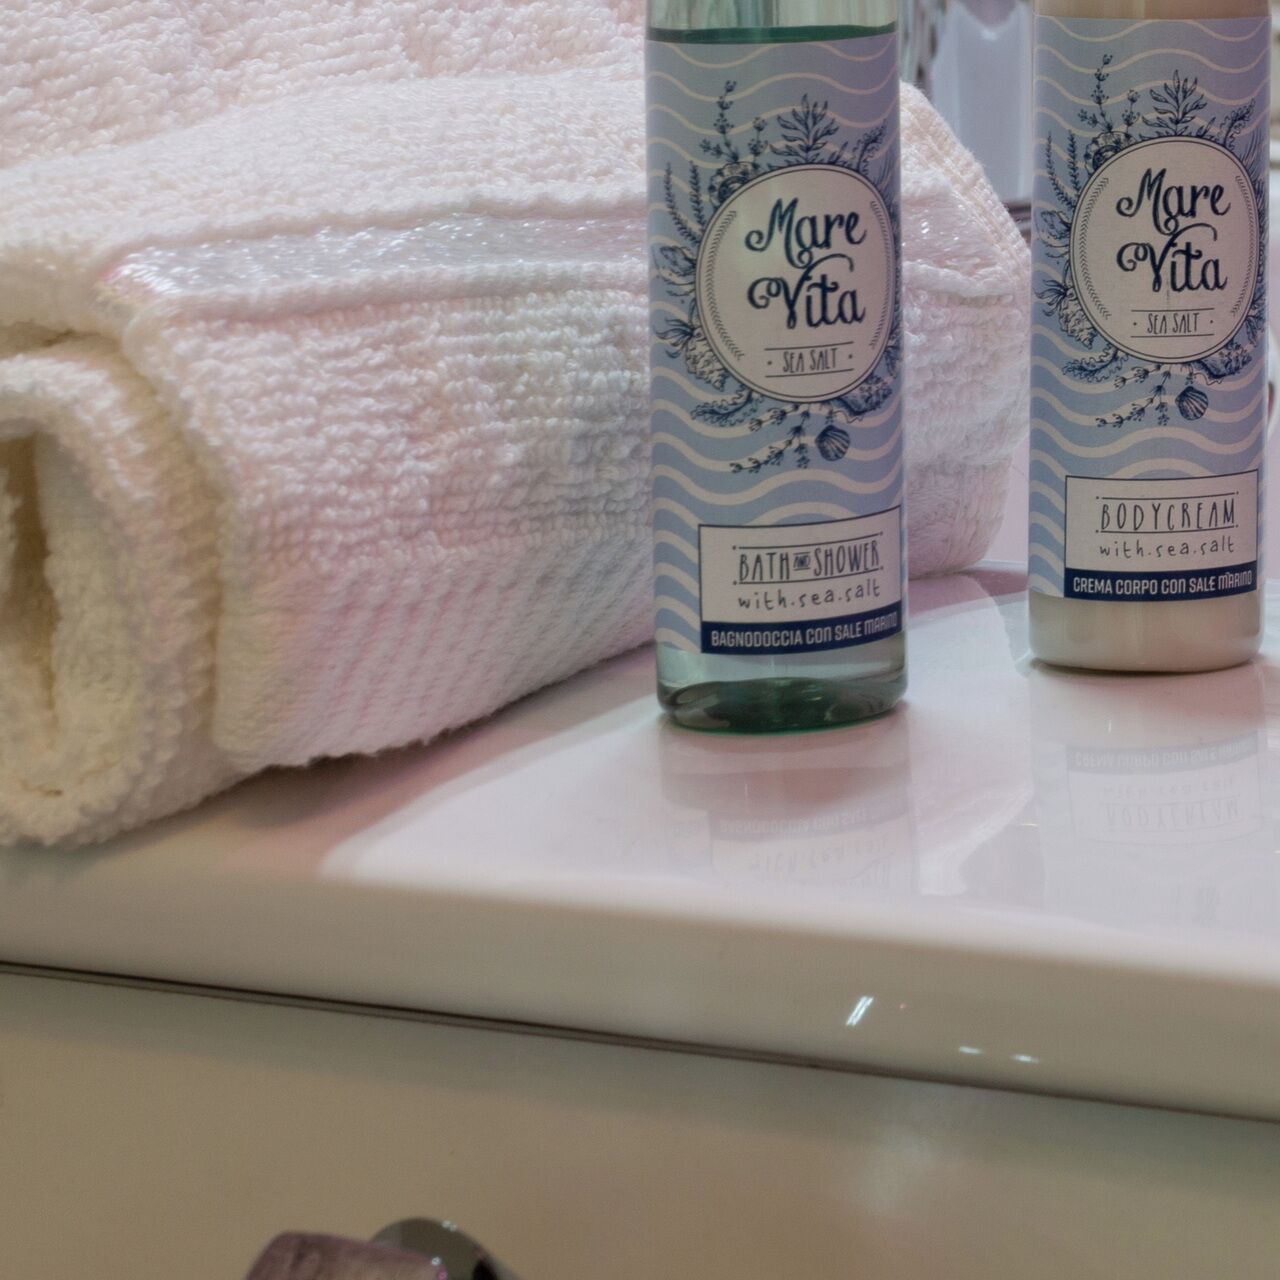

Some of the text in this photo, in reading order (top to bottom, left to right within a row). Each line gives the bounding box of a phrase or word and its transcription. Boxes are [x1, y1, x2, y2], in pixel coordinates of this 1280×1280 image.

[1116, 168, 1231, 236] Mare
[745, 197, 867, 269] Mare
[1116, 223, 1228, 293] Vita
[747, 253, 866, 330] Vita
[1147, 312, 1199, 335] SEA SALT
[783, 348, 838, 372] SEA SALT
[1101, 498, 1235, 531] BODYCREAM
[739, 551, 790, 581] BATH
[814, 540, 879, 577] SHOWER
[1073, 577, 1113, 594] CREMA
[1116, 578, 1158, 595] CORPO
[1189, 575, 1216, 592] SALE
[711, 628, 803, 648] BAGNODOCCIA
[834, 620, 862, 641] SALE
